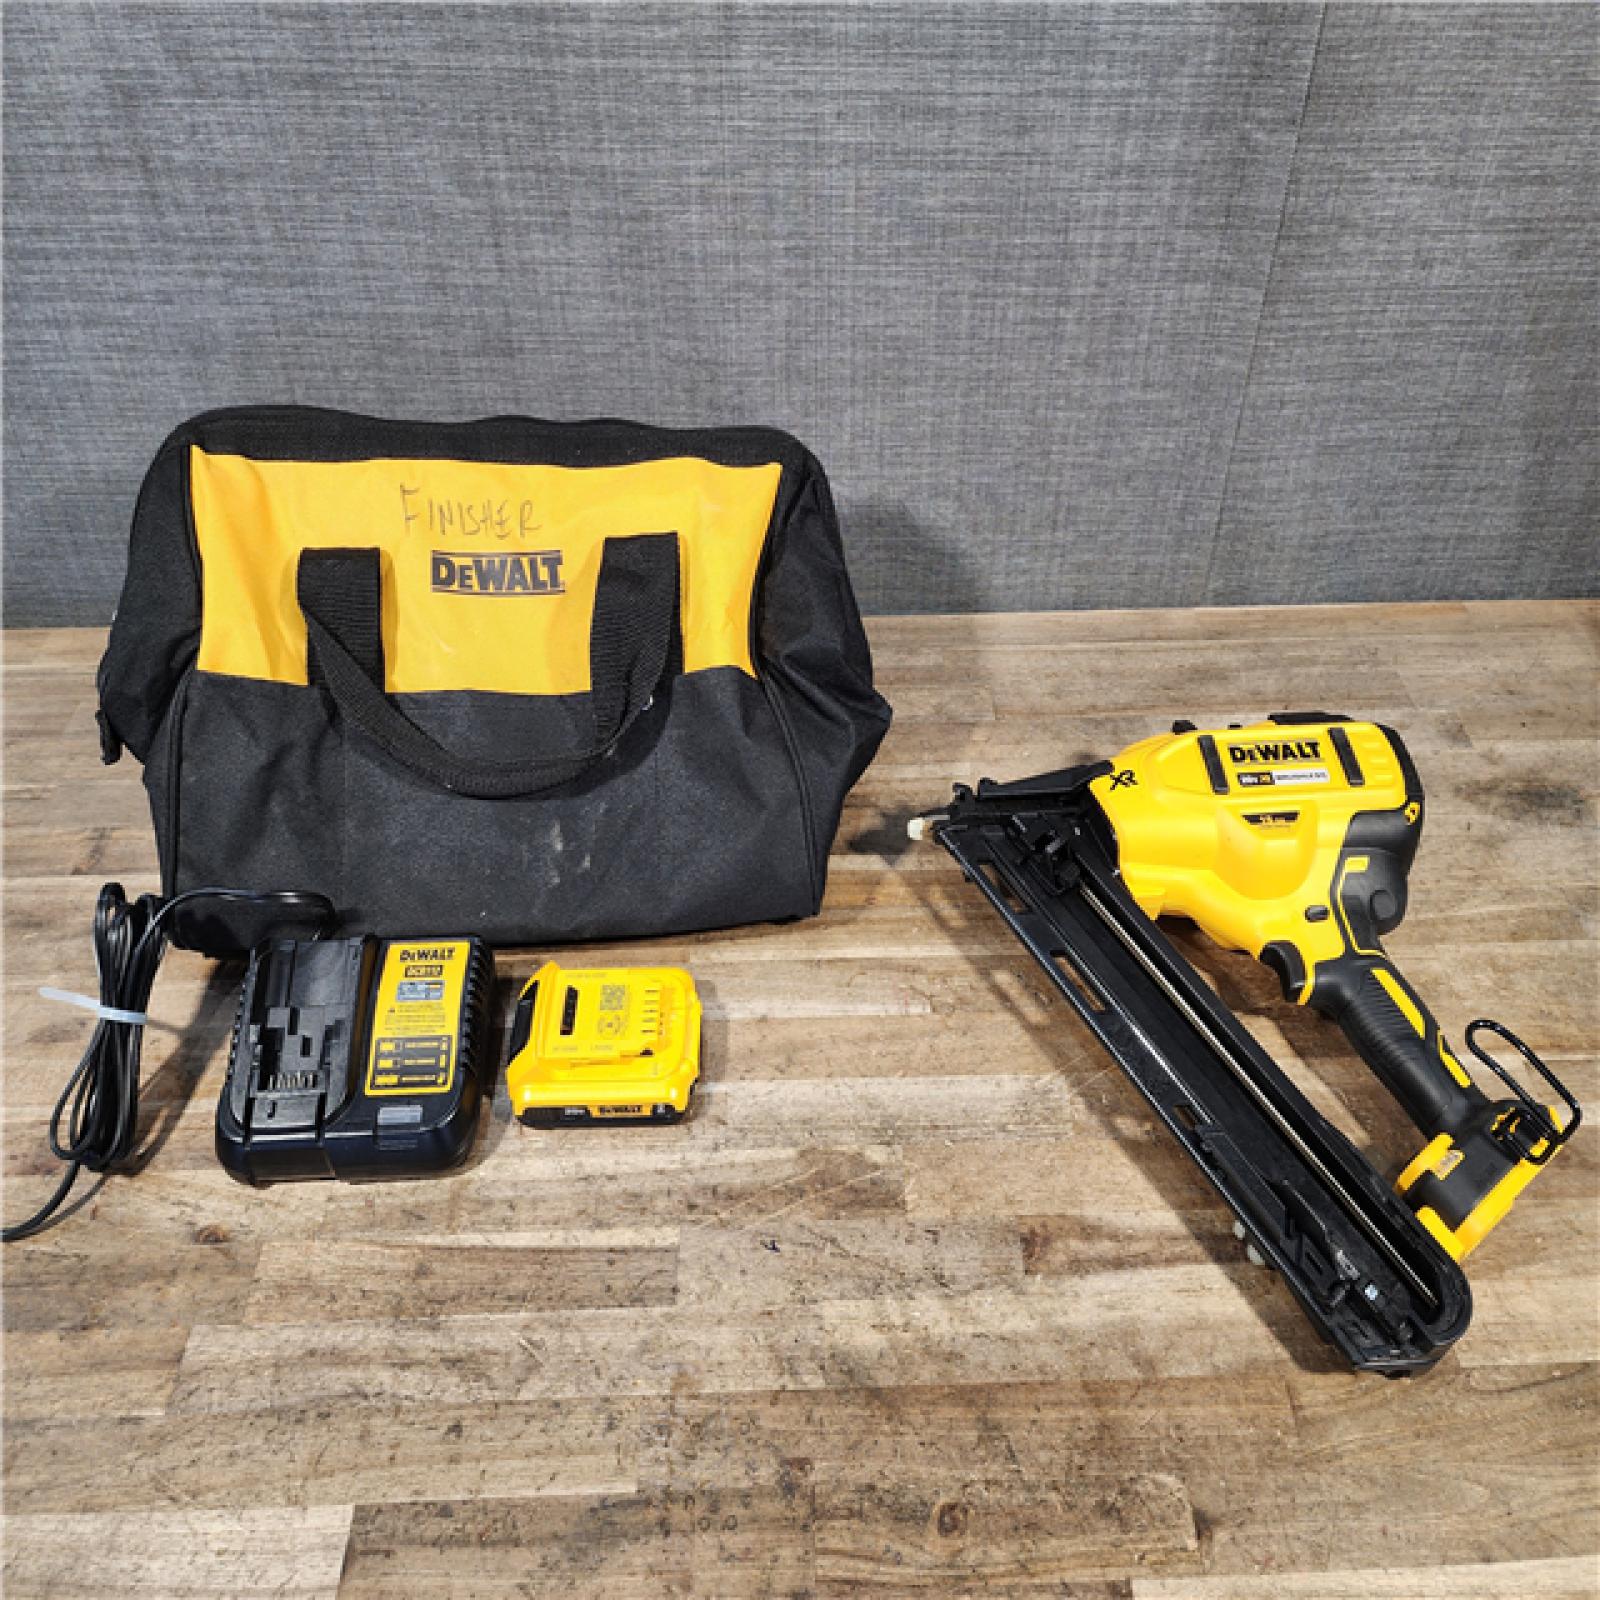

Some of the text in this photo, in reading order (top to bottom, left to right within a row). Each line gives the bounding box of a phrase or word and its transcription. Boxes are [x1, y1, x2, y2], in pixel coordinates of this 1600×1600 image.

[399, 483, 542, 540] FINISHER
[431, 553, 564, 593] DEWALT
[1228, 741, 1321, 763] DEWALT
